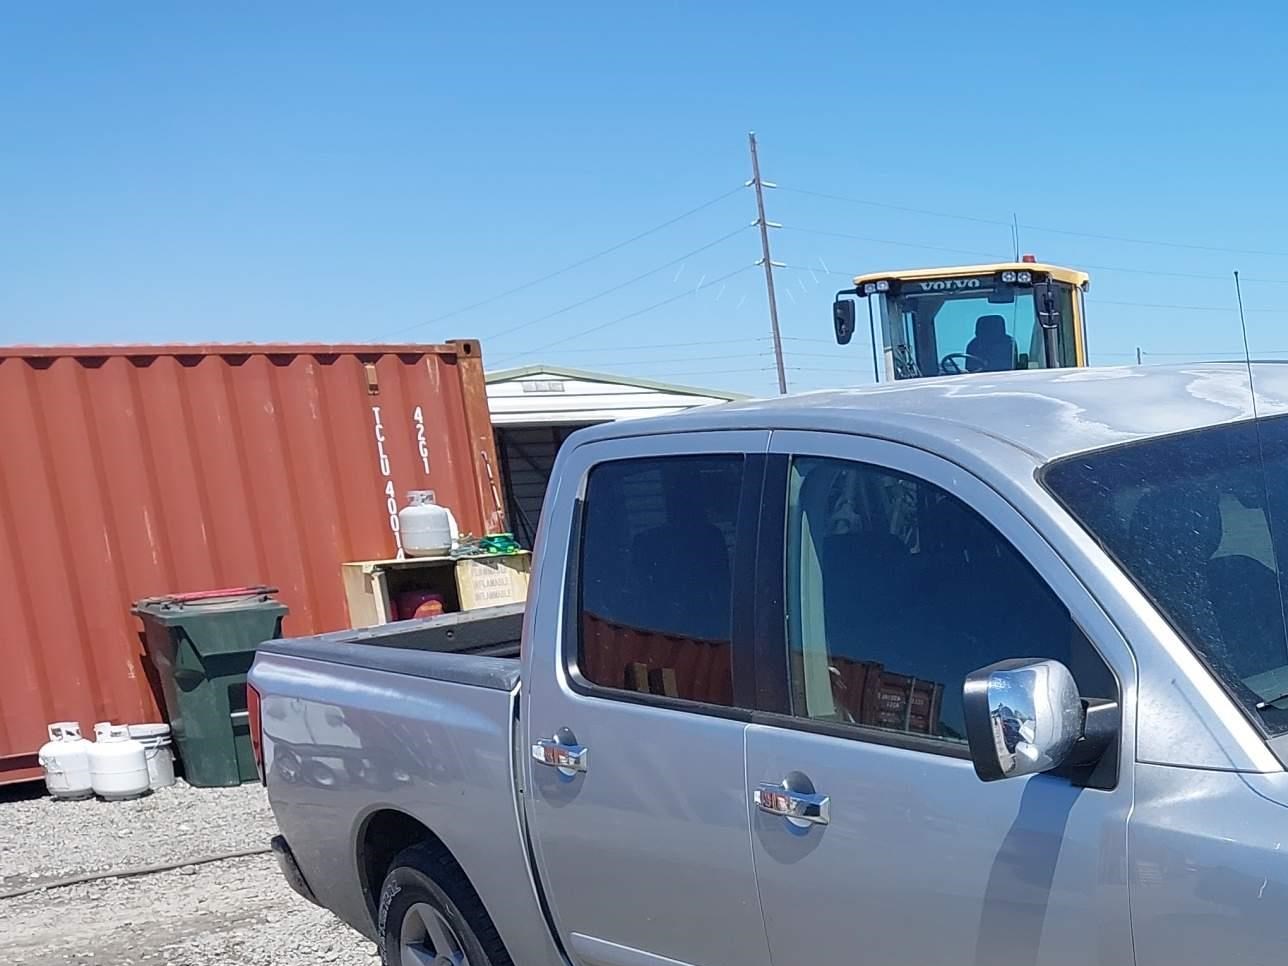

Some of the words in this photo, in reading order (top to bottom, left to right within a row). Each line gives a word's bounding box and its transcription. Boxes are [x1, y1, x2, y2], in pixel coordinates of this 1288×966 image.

[920, 278, 980, 291] VOLVO
[372, 407, 391, 476] TCLU
[414, 406, 430, 475] 42G1
